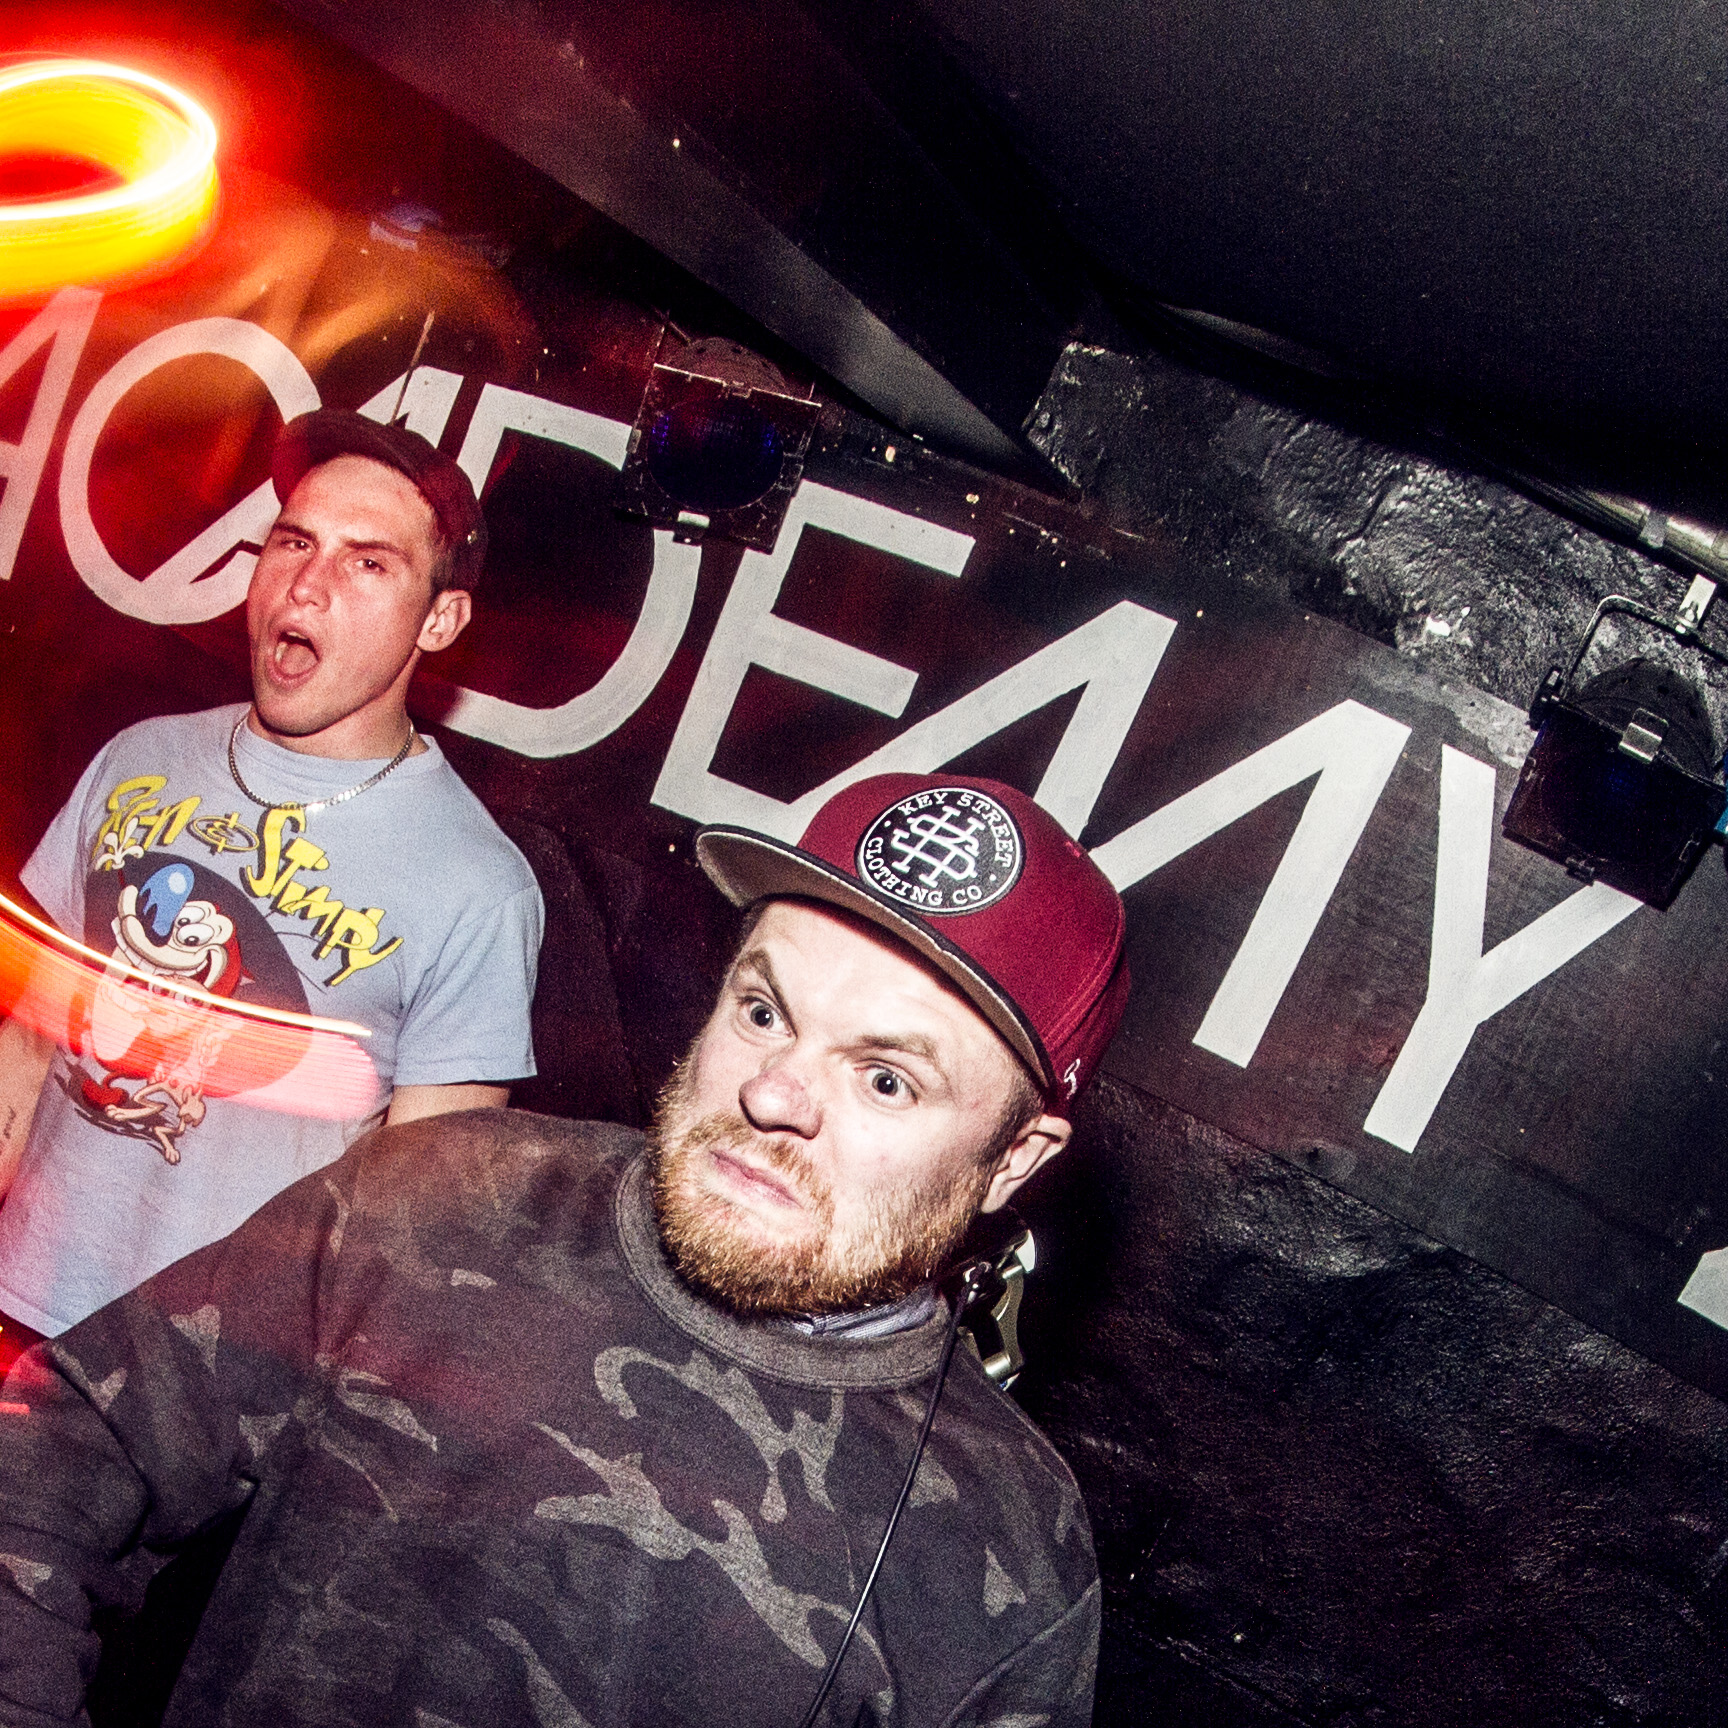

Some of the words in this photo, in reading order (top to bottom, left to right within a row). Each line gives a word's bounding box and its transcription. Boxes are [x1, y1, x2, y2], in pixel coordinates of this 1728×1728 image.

[898, 791, 950, 817] KEY
[957, 794, 1012, 869] STREET
[866, 836, 943, 906] CLOTHING
[954, 884, 983, 906] CO
